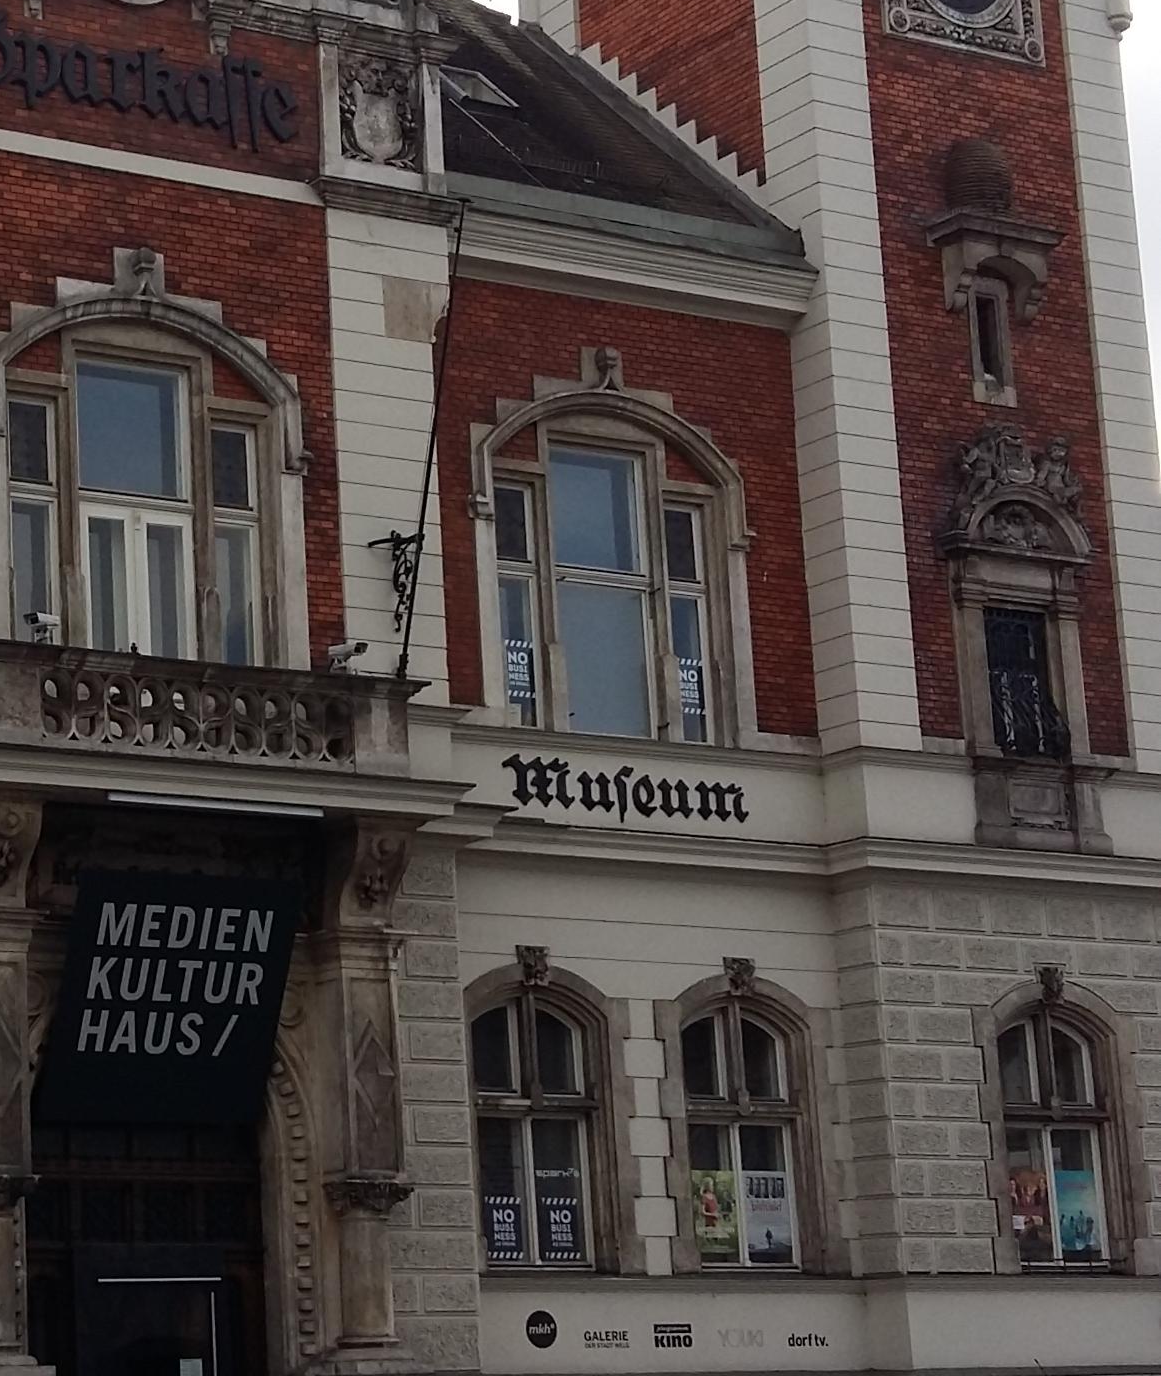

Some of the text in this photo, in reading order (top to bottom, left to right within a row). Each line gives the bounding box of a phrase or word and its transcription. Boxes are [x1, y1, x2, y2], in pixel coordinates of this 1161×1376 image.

[508, 651, 528, 665] NO
[679, 669, 698, 682] NO
[501, 753, 749, 823] Museum
[96, 902, 274, 952] MEDIEN
[86, 956, 264, 1005] KULTUR
[77, 1009, 204, 1055] HAUS
[493, 1209, 515, 1223] NO
[550, 1210, 571, 1223] NO
[584, 1330, 629, 1342] GALERIE
